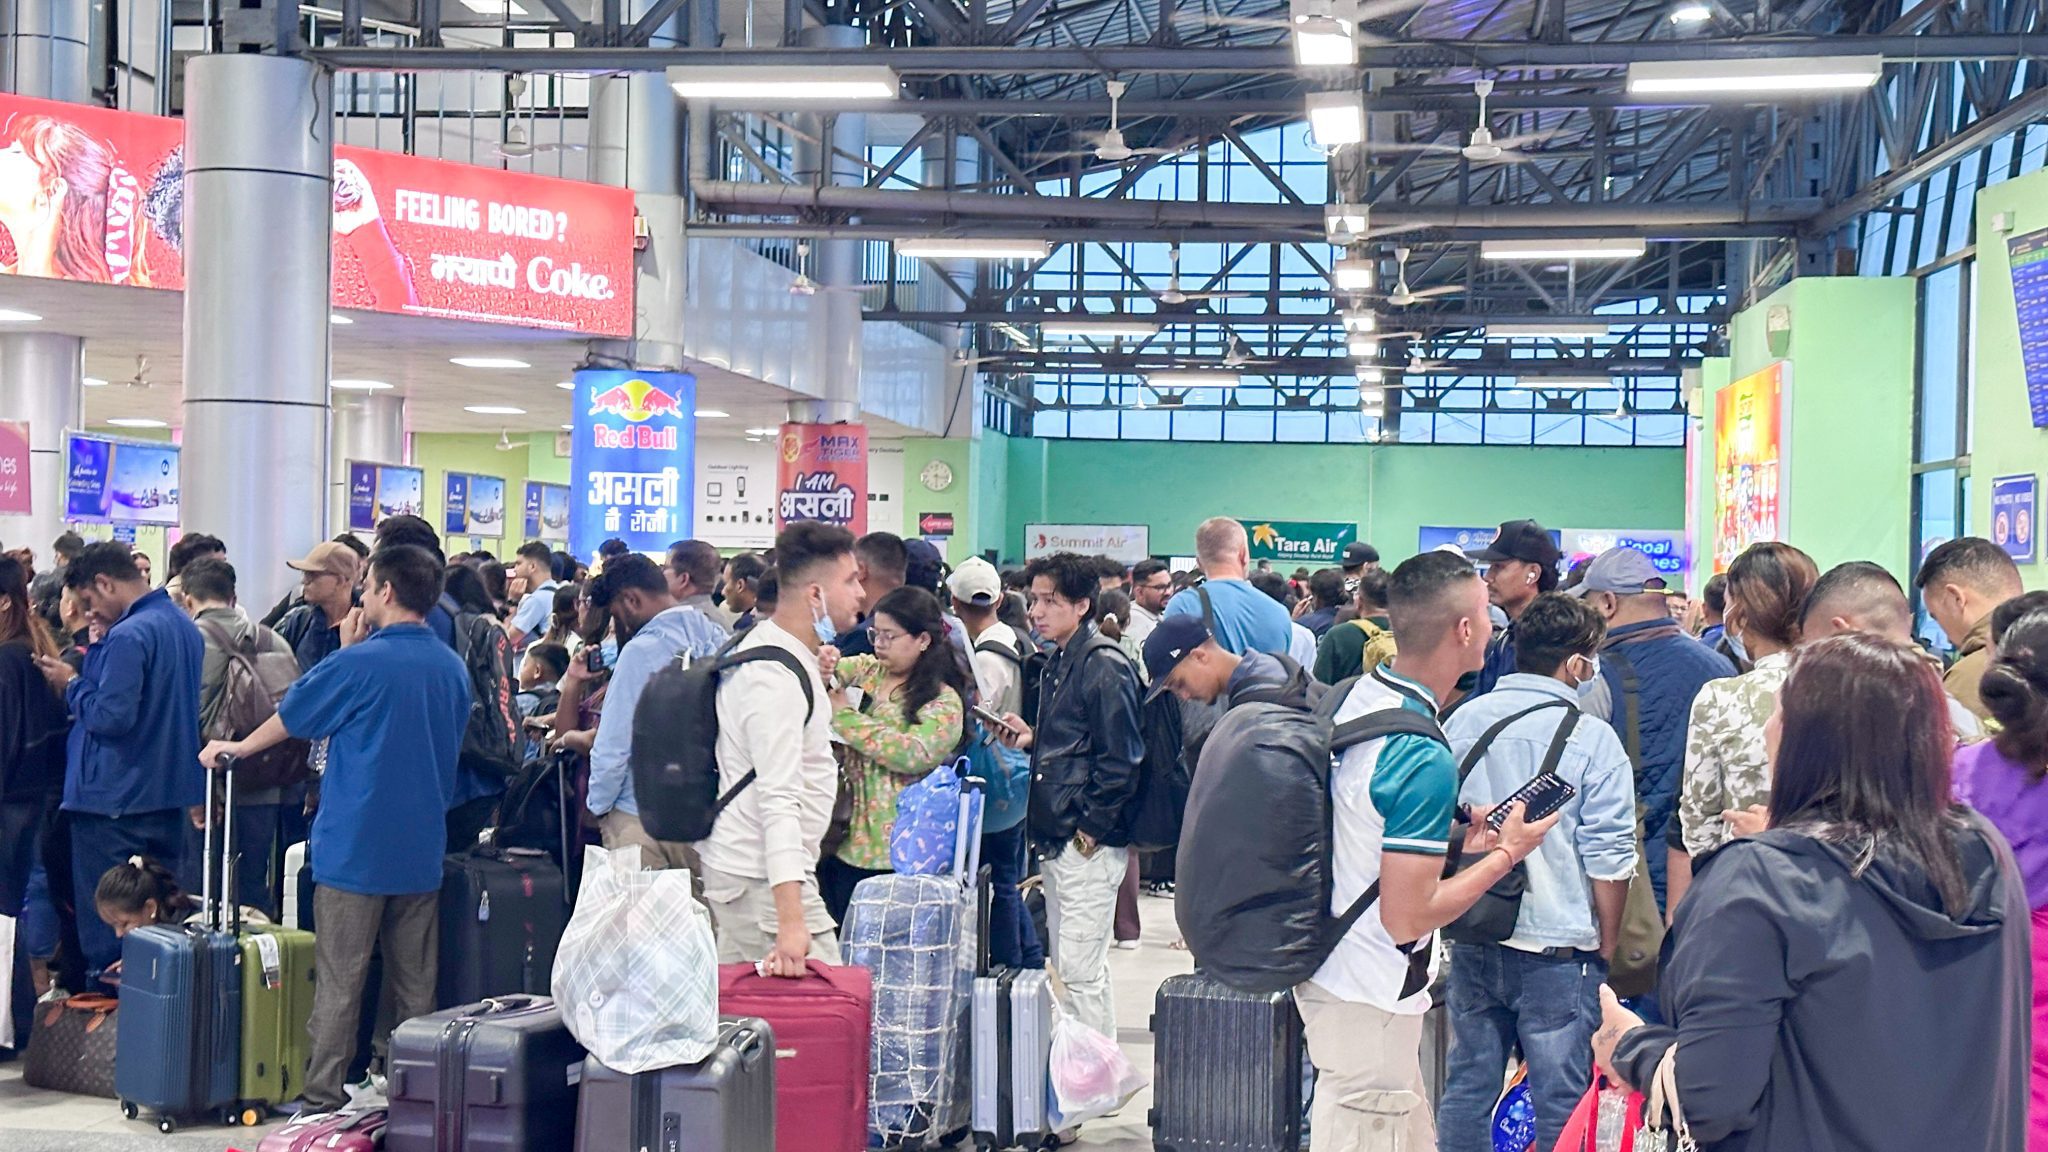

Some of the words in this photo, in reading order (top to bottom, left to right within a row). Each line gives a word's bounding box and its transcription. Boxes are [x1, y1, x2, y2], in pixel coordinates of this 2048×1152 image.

[396, 189, 480, 231] FEELING
[488, 202, 567, 243] BORED?
[526, 256, 614, 301] Coke.
[594, 424, 635, 449] Red
[637, 425, 677, 450] Bull
[821, 436, 858, 448] MAX
[588, 466, 680, 507] असली
[796, 474, 803, 491] I
[805, 474, 836, 491] AM
[781, 487, 854, 518] असली
[604, 507, 622, 532] नै
[1050, 535, 1106, 548] Summit
[1107, 537, 1128, 548] Air
[1275, 537, 1310, 552] Tara
[1313, 538, 1338, 553] Air
